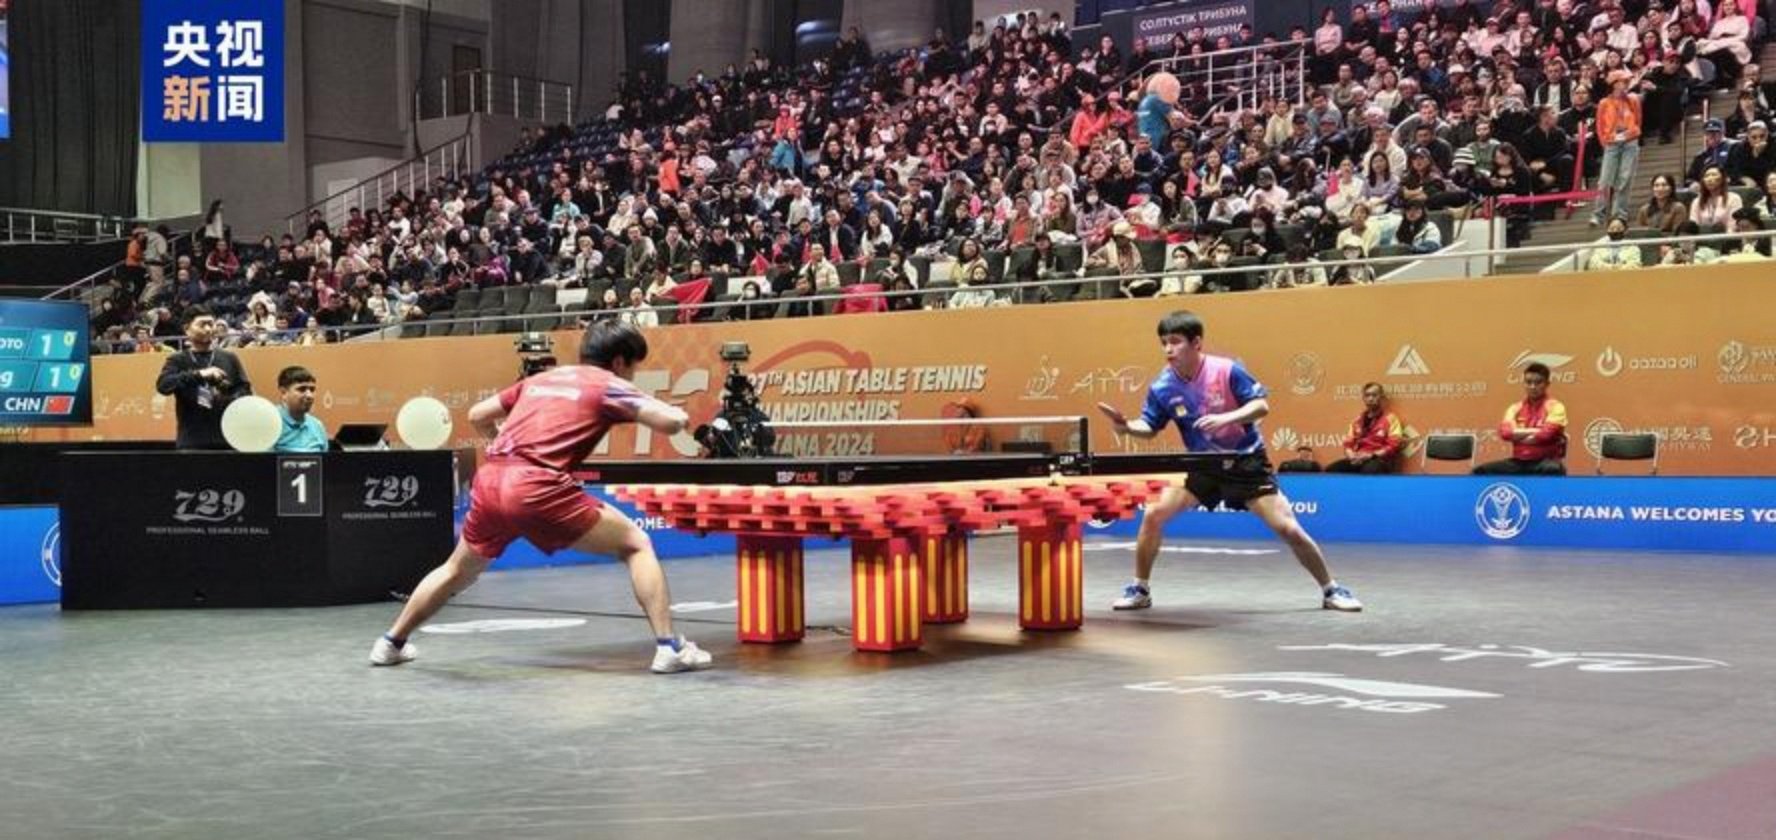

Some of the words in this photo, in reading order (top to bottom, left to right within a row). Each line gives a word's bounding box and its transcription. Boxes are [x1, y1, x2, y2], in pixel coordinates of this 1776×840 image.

[41, 334, 52, 356] 1
[50, 367, 61, 388] 1
[782, 368, 840, 394] ASIAN
[848, 367, 906, 392] TABLE
[912, 364, 987, 392] TENNIS
[5, 397, 41, 411] CHN
[823, 432, 876, 456] 2024
[290, 473, 307, 503] 1
[364, 475, 419, 507] 729
[173, 489, 245, 522] 729
[1547, 505, 1625, 520] ASTANA
[1631, 506, 1745, 522] WELCOMES
